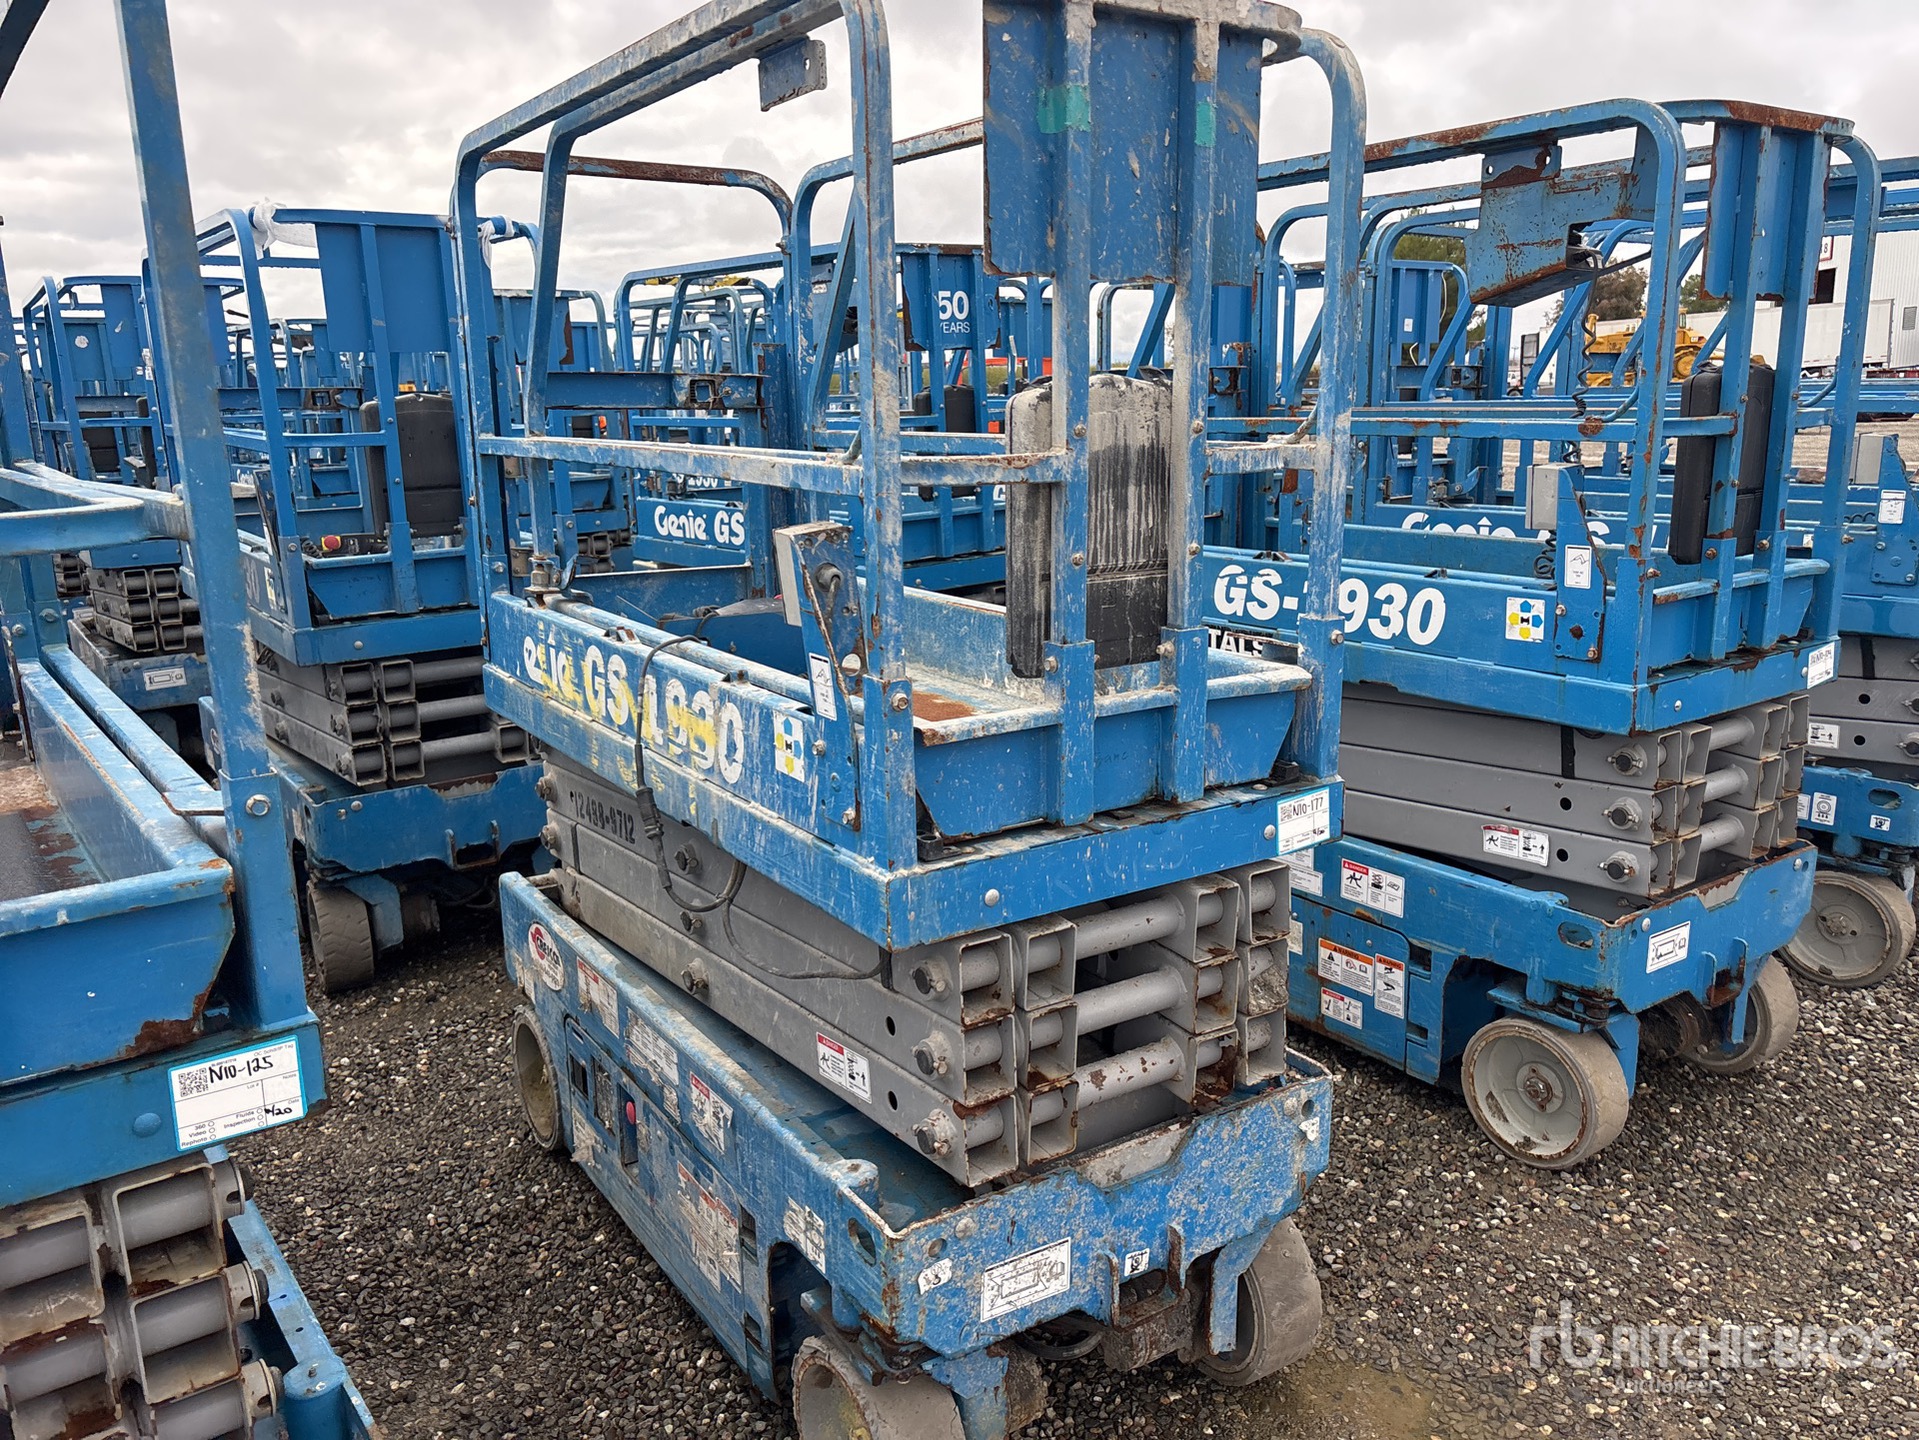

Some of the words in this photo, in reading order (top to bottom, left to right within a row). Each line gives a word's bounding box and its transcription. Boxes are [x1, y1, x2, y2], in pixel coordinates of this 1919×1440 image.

[938, 290, 970, 320] 50
[653, 505, 709, 541] Genie
[713, 509, 746, 546] GS
[1213, 564, 1447, 647] GS-930
[1292, 796, 1324, 816] N10-177
[208, 1055, 274, 1084] N10-125
[223, 1116, 256, 1129] Inspection
[235, 1110, 255, 1119] Fluids
[188, 1130, 207, 1138] Video
[194, 1123, 207, 1131] 360
[180, 1137, 208, 1148] Rephoto
